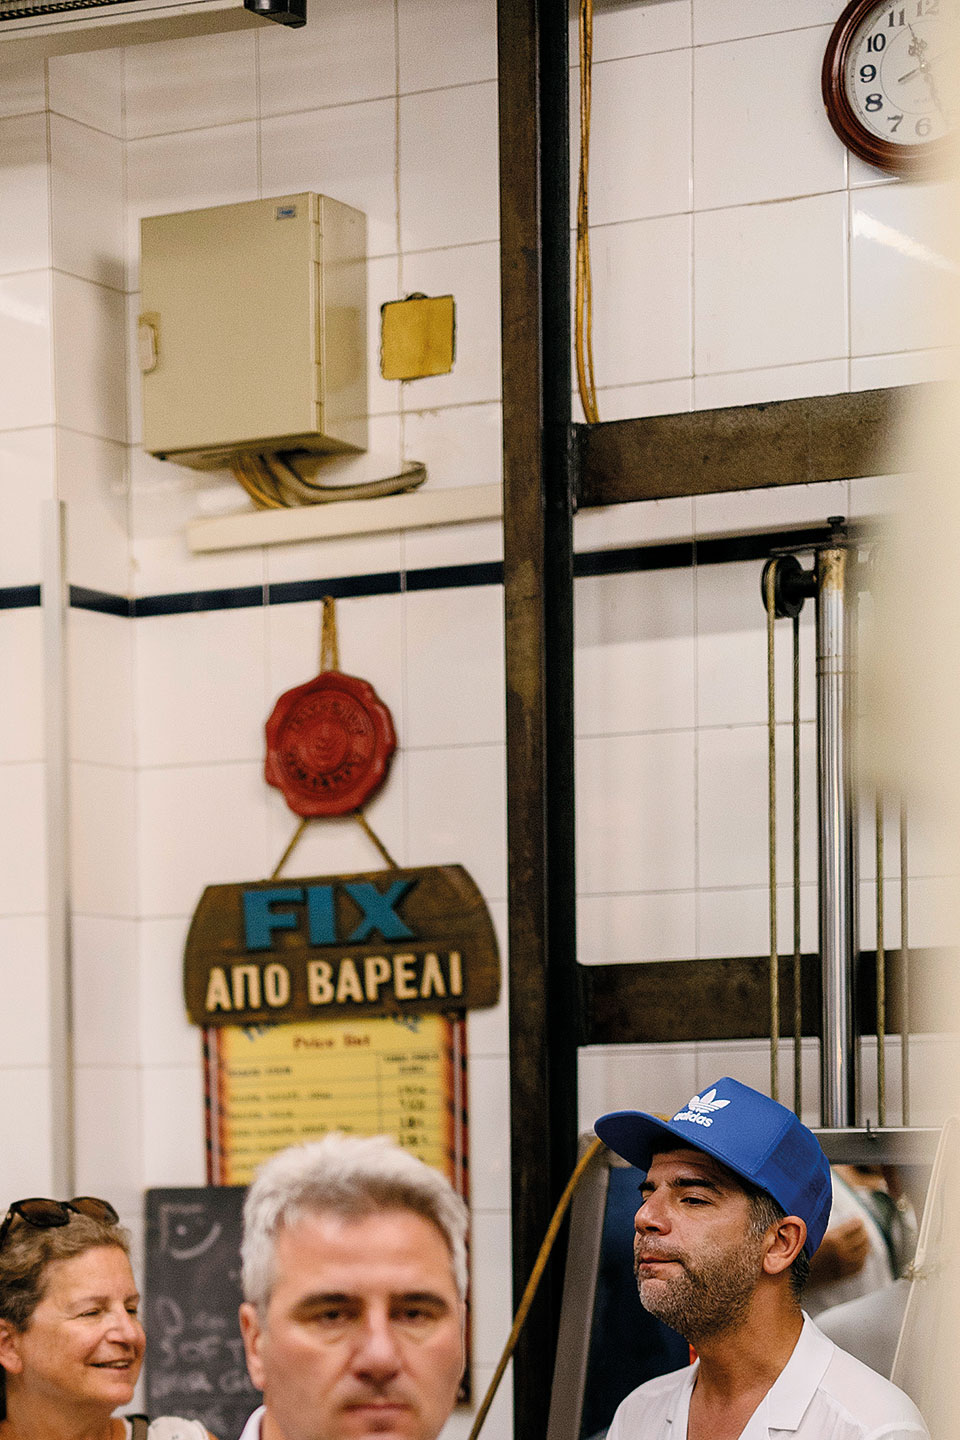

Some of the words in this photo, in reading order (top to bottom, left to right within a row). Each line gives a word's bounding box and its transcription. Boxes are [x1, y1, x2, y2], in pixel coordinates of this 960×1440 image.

[888, 9, 905, 27] 11
[866, 33, 886, 52] 10
[860, 64, 877, 83] 9
[865, 93, 883, 112] 8
[887, 114, 904, 133] 7
[915, 117, 932, 137] 6
[244, 880, 416, 949] FIX
[205, 962, 291, 1012] ΑΠΟ
[307, 951, 463, 1005] ΒΑΡΕΛΙ
[673, 1110, 714, 1128] adidas
